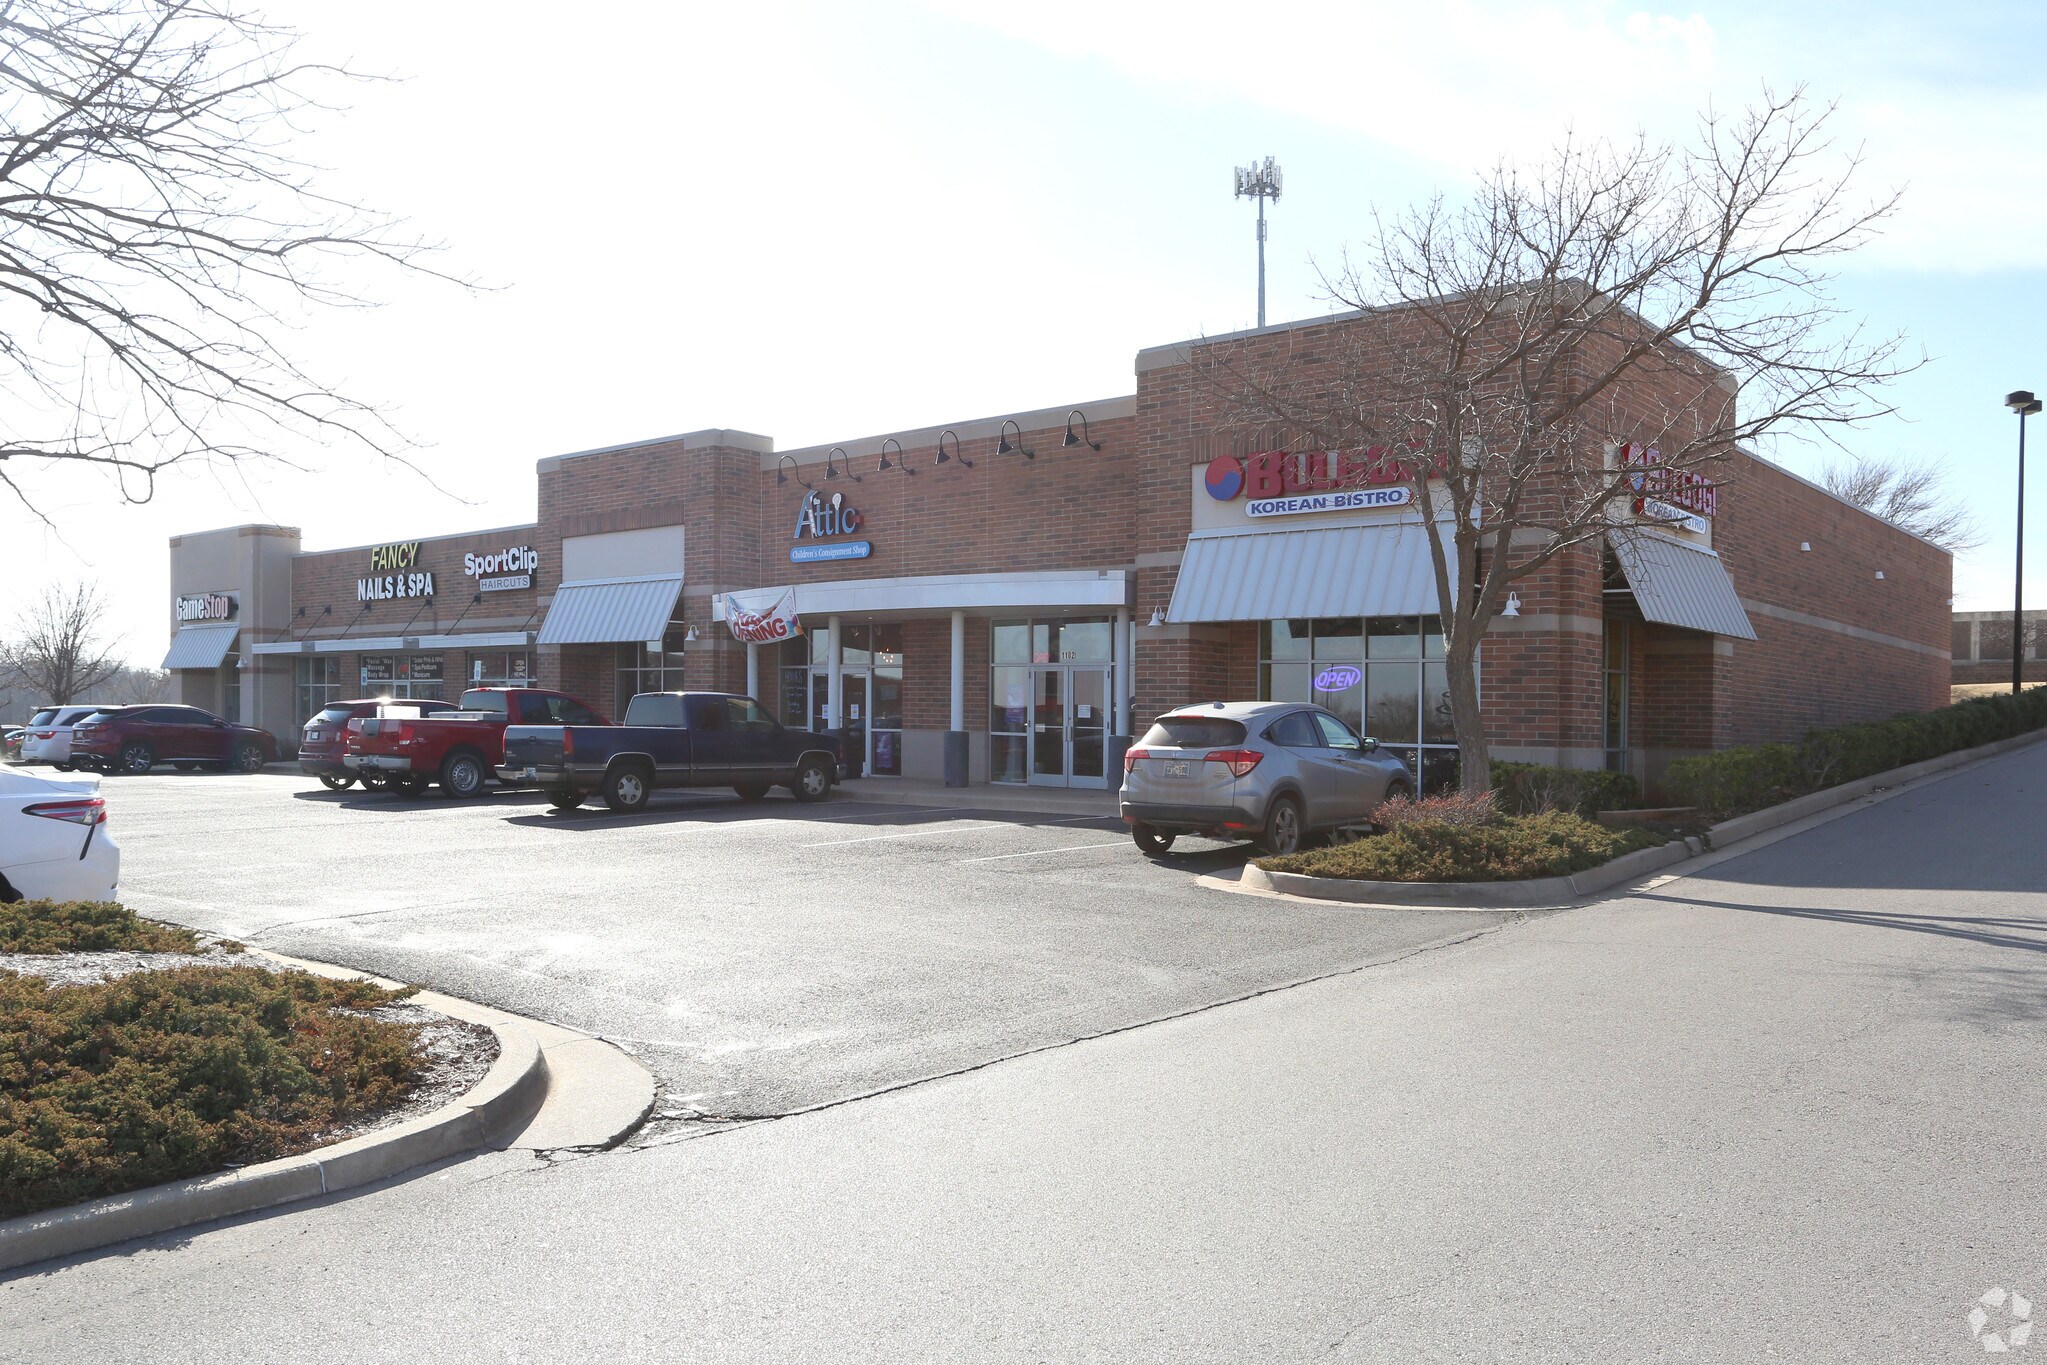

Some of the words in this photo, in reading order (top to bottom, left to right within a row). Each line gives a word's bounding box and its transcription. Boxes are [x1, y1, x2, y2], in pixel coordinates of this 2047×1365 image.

[794, 489, 856, 538] Attic
[1251, 496, 1327, 515] KOREAN
[1334, 489, 1403, 508] BISTRO
[1679, 513, 1705, 531] STRO
[370, 541, 419, 571] FANCY
[464, 545, 538, 580] SportClip
[818, 547, 852, 559] Consignment
[853, 545, 867, 556] Shop
[357, 575, 394, 601] NAILS
[396, 574, 406, 598] &
[407, 572, 434, 598] SPA
[481, 576, 529, 590] HAIRCUTS
[176, 592, 229, 621] GameStop
[733, 617, 787, 641] ONING
[1317, 671, 1356, 687] OPEN
